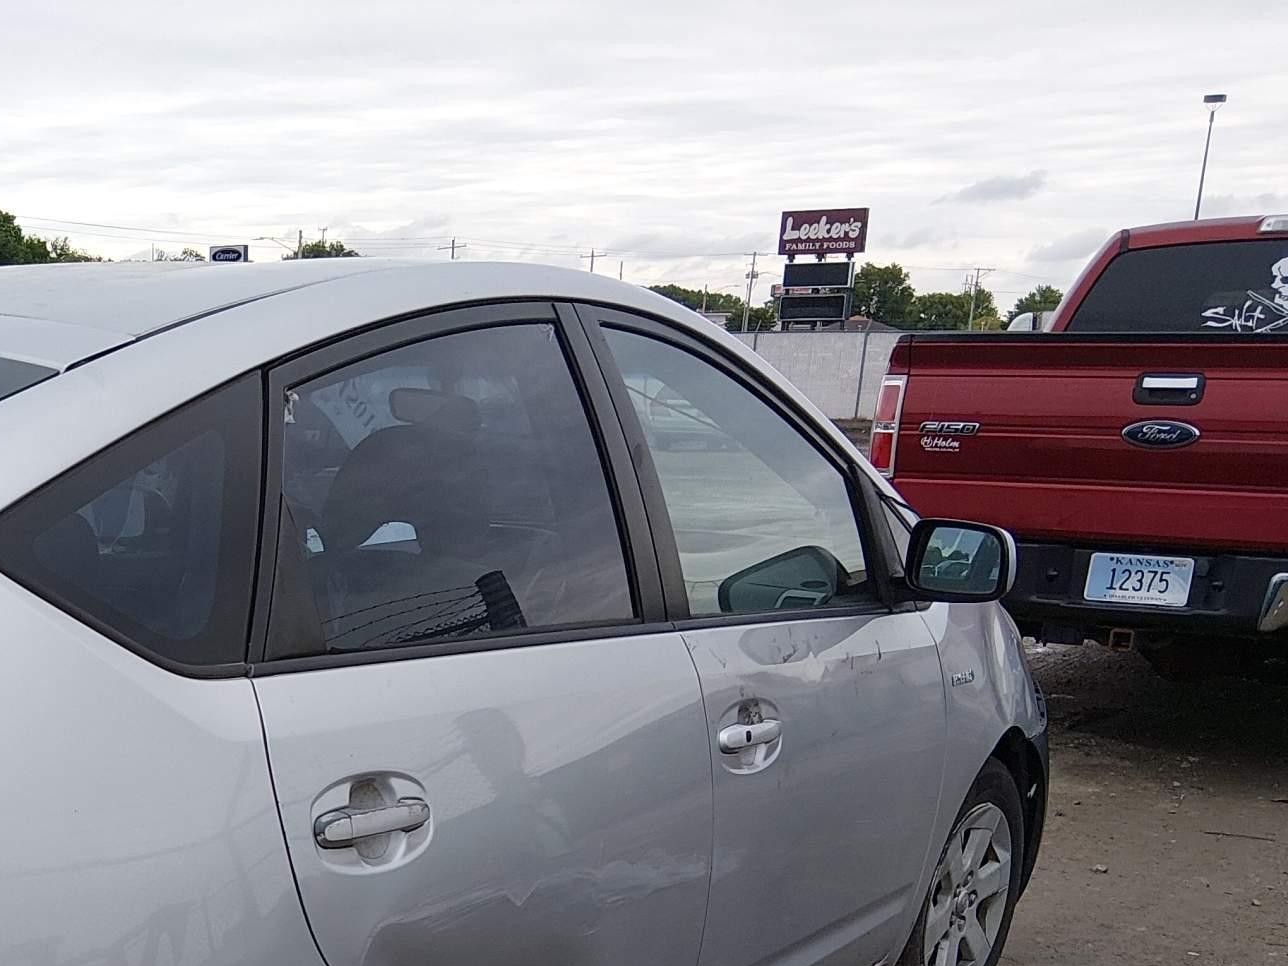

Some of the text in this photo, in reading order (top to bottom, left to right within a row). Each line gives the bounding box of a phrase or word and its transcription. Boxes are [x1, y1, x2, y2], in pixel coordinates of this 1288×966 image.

[782, 215, 862, 240] Leeker's
[785, 241, 856, 250] FAMILY FOODS
[1137, 424, 1181, 441] Ford
[1115, 556, 1171, 569] KANSAS
[1105, 567, 1172, 594] 12375
